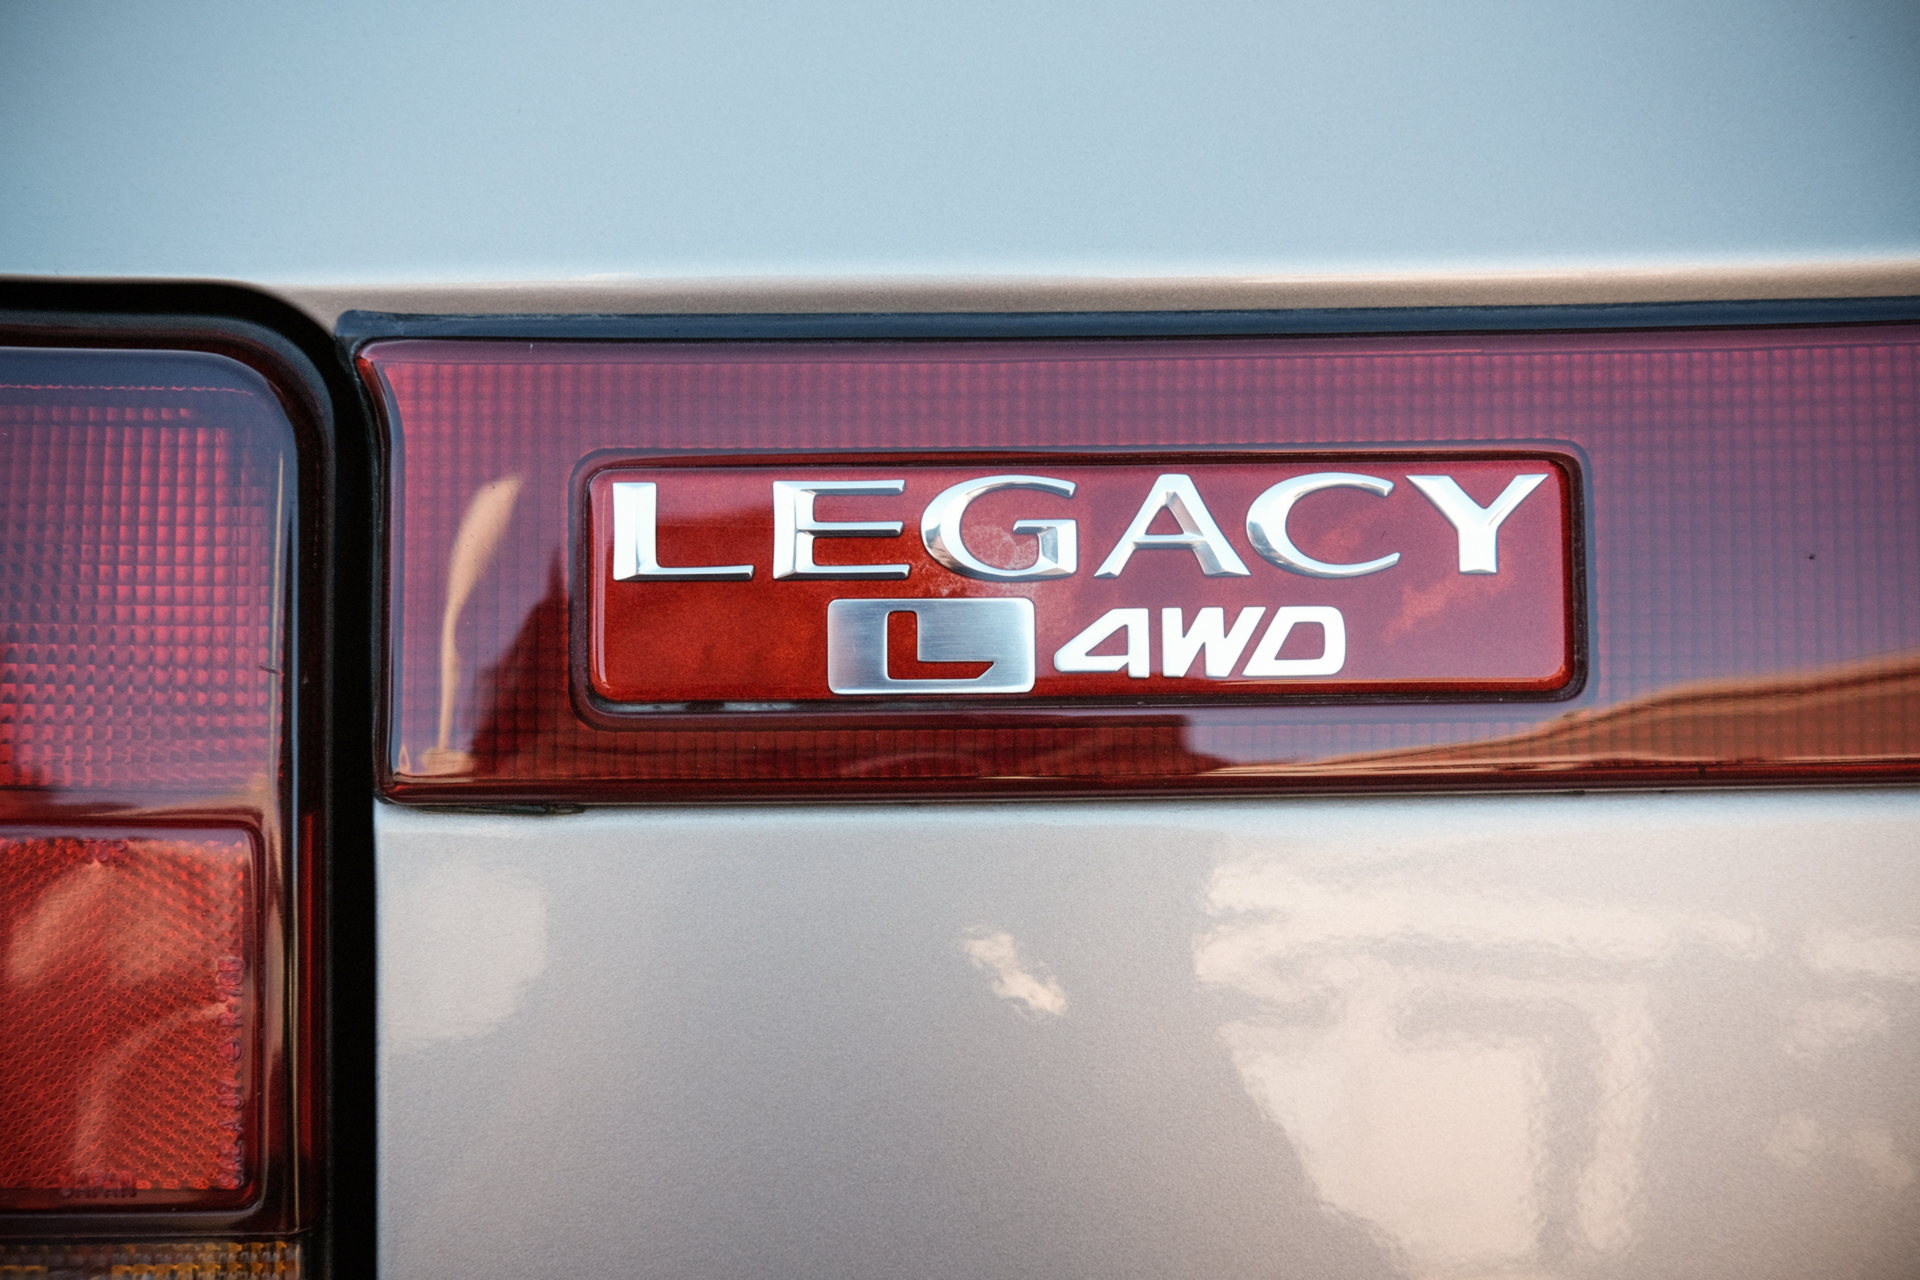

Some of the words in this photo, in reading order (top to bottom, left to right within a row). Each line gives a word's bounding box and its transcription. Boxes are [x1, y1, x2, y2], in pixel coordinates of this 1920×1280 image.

[612, 472, 1549, 582] LEGACY
[887, 610, 995, 681] L
[1054, 605, 1346, 678] 4WD
